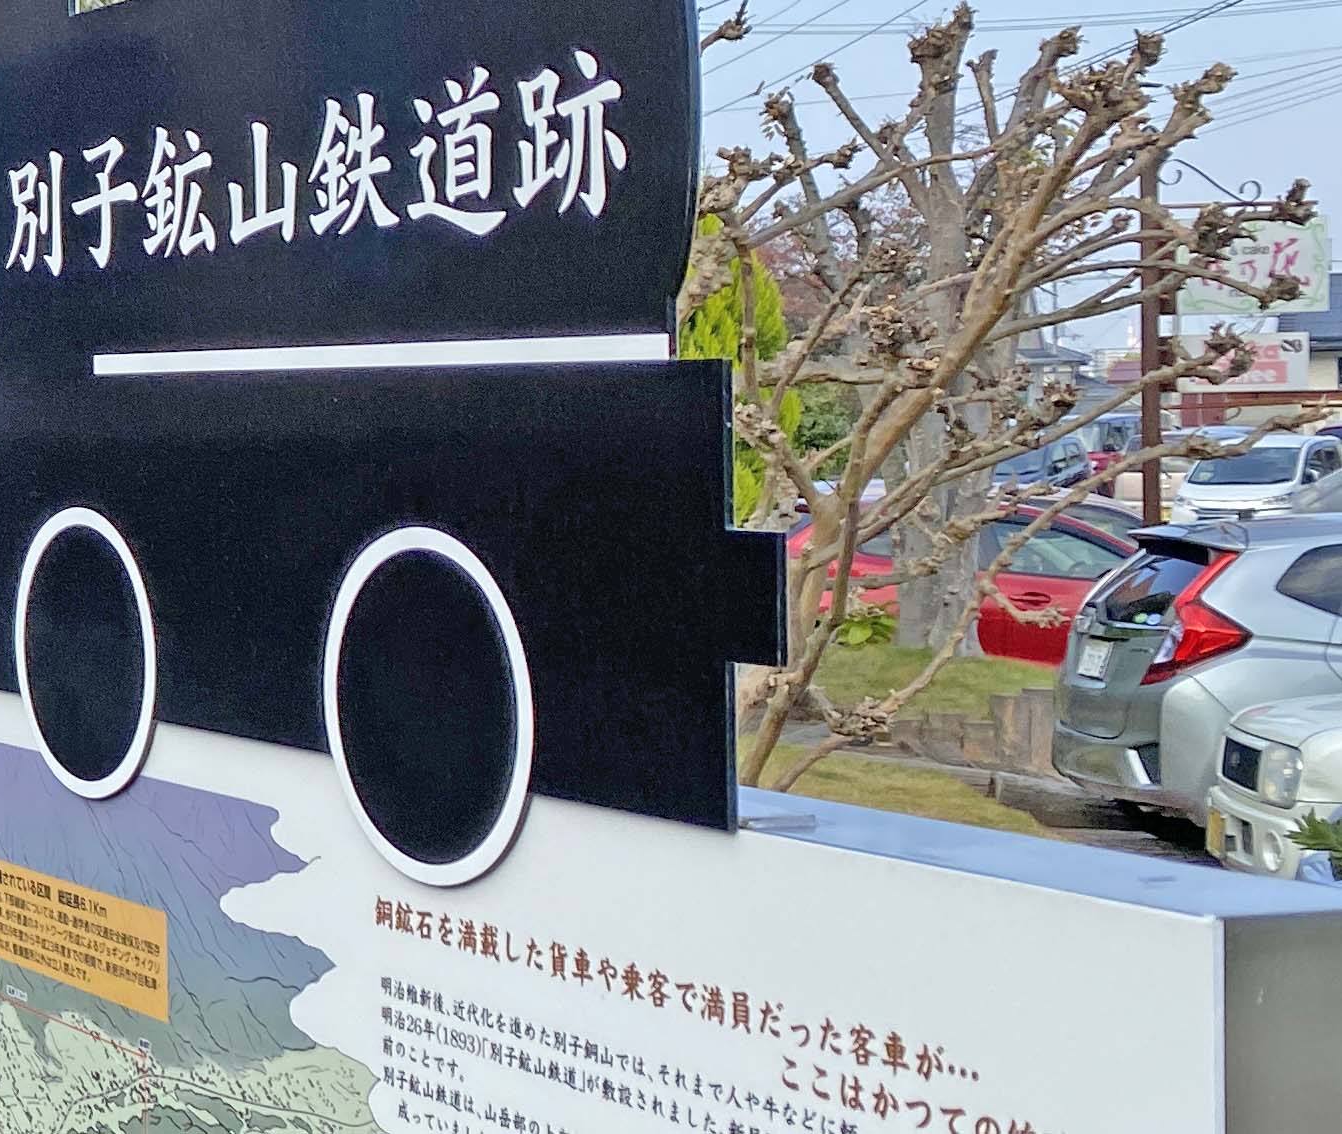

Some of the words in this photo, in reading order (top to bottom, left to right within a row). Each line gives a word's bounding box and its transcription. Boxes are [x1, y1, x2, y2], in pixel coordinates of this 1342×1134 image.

[5, 48, 627, 276] 別子鉱山鉄道跡
[1242, 246, 1270, 255] cake
[382, 1035, 465, 1082] 前のことです。
